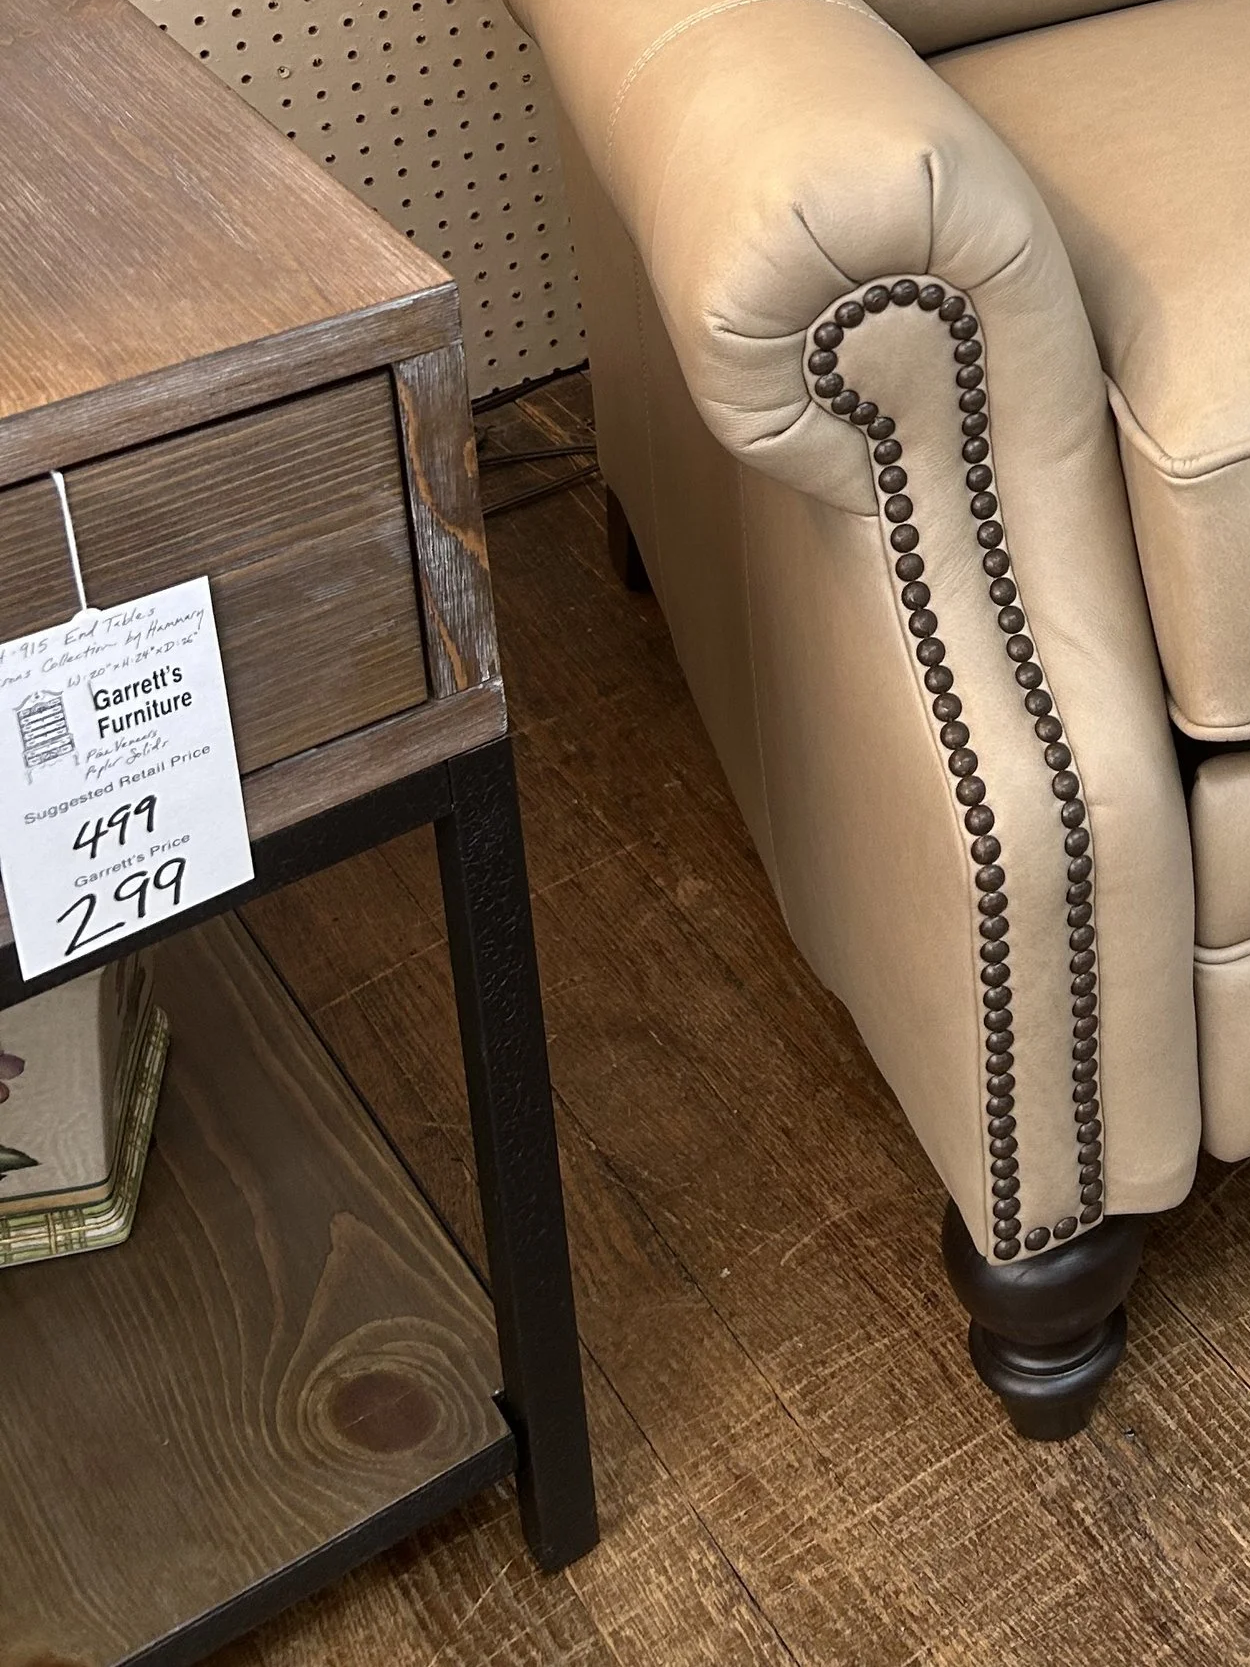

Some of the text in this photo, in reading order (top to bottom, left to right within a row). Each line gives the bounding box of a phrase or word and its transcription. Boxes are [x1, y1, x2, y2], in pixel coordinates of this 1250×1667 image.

[41, 641, 117, 673] Collection
[124, 630, 142, 650] by
[64, 619, 99, 646] End
[102, 606, 156, 633] Tables
[93, 665, 184, 711] Garrett's
[97, 691, 193, 740] Furniture
[23, 744, 211, 826] Suggested Retail Price
[72, 793, 158, 860] 499
[73, 833, 191, 889] Garrett's Price
[56, 856, 187, 958] 299
